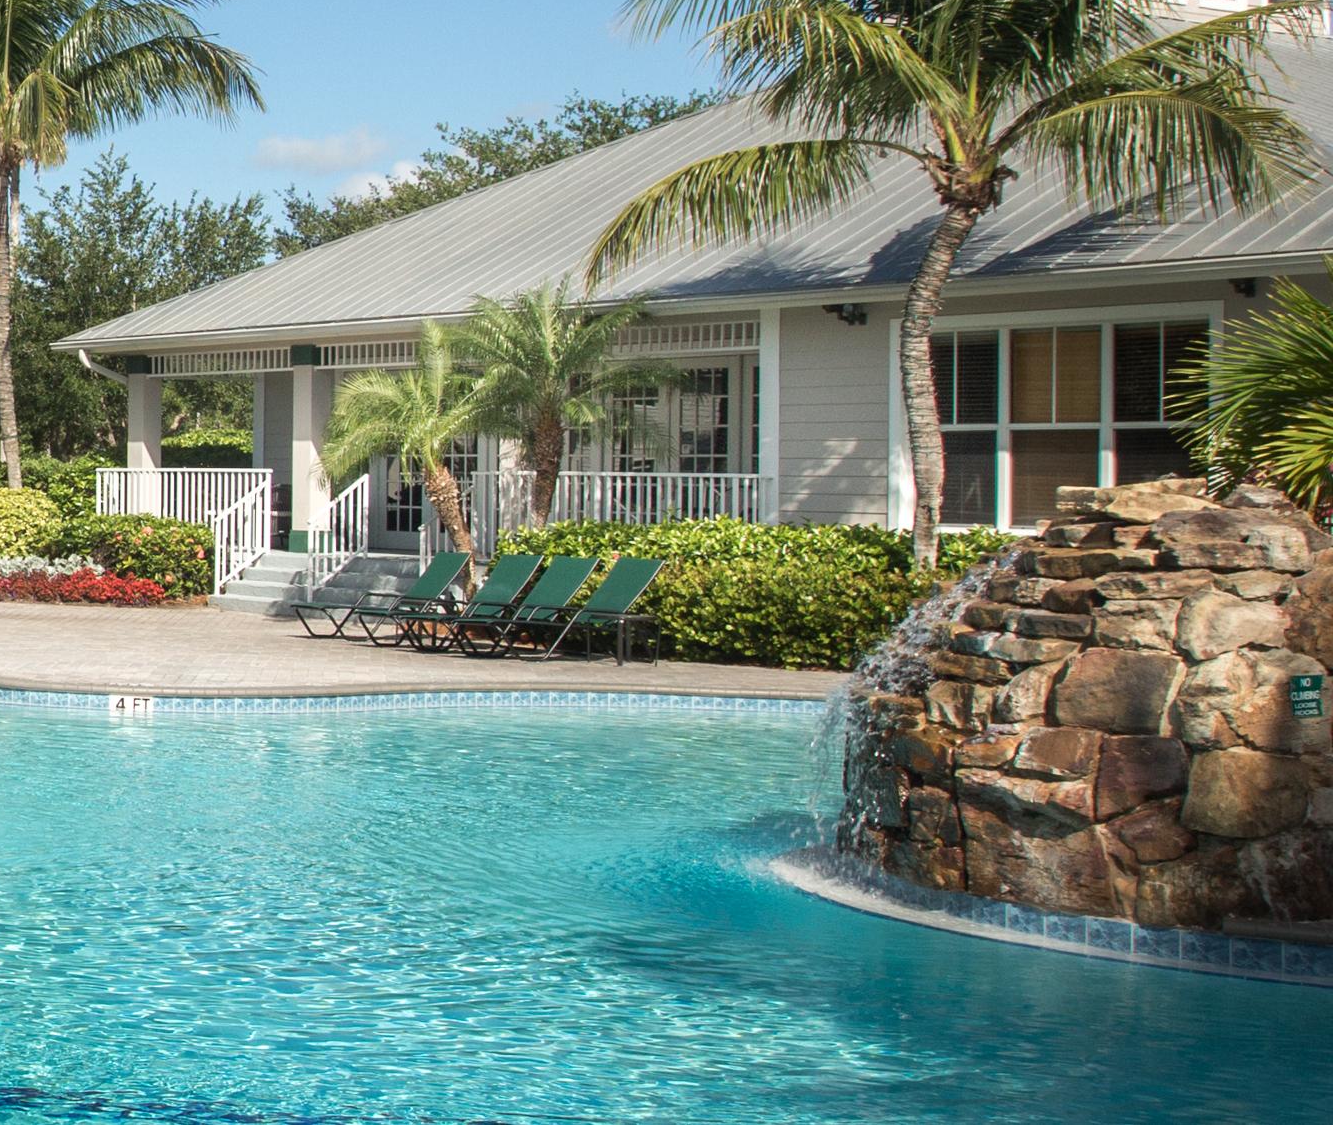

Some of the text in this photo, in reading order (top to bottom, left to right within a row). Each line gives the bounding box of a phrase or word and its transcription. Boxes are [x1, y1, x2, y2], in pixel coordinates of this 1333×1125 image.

[1300, 678, 1311, 687] NO
[116, 697, 150, 713] 4 FT
